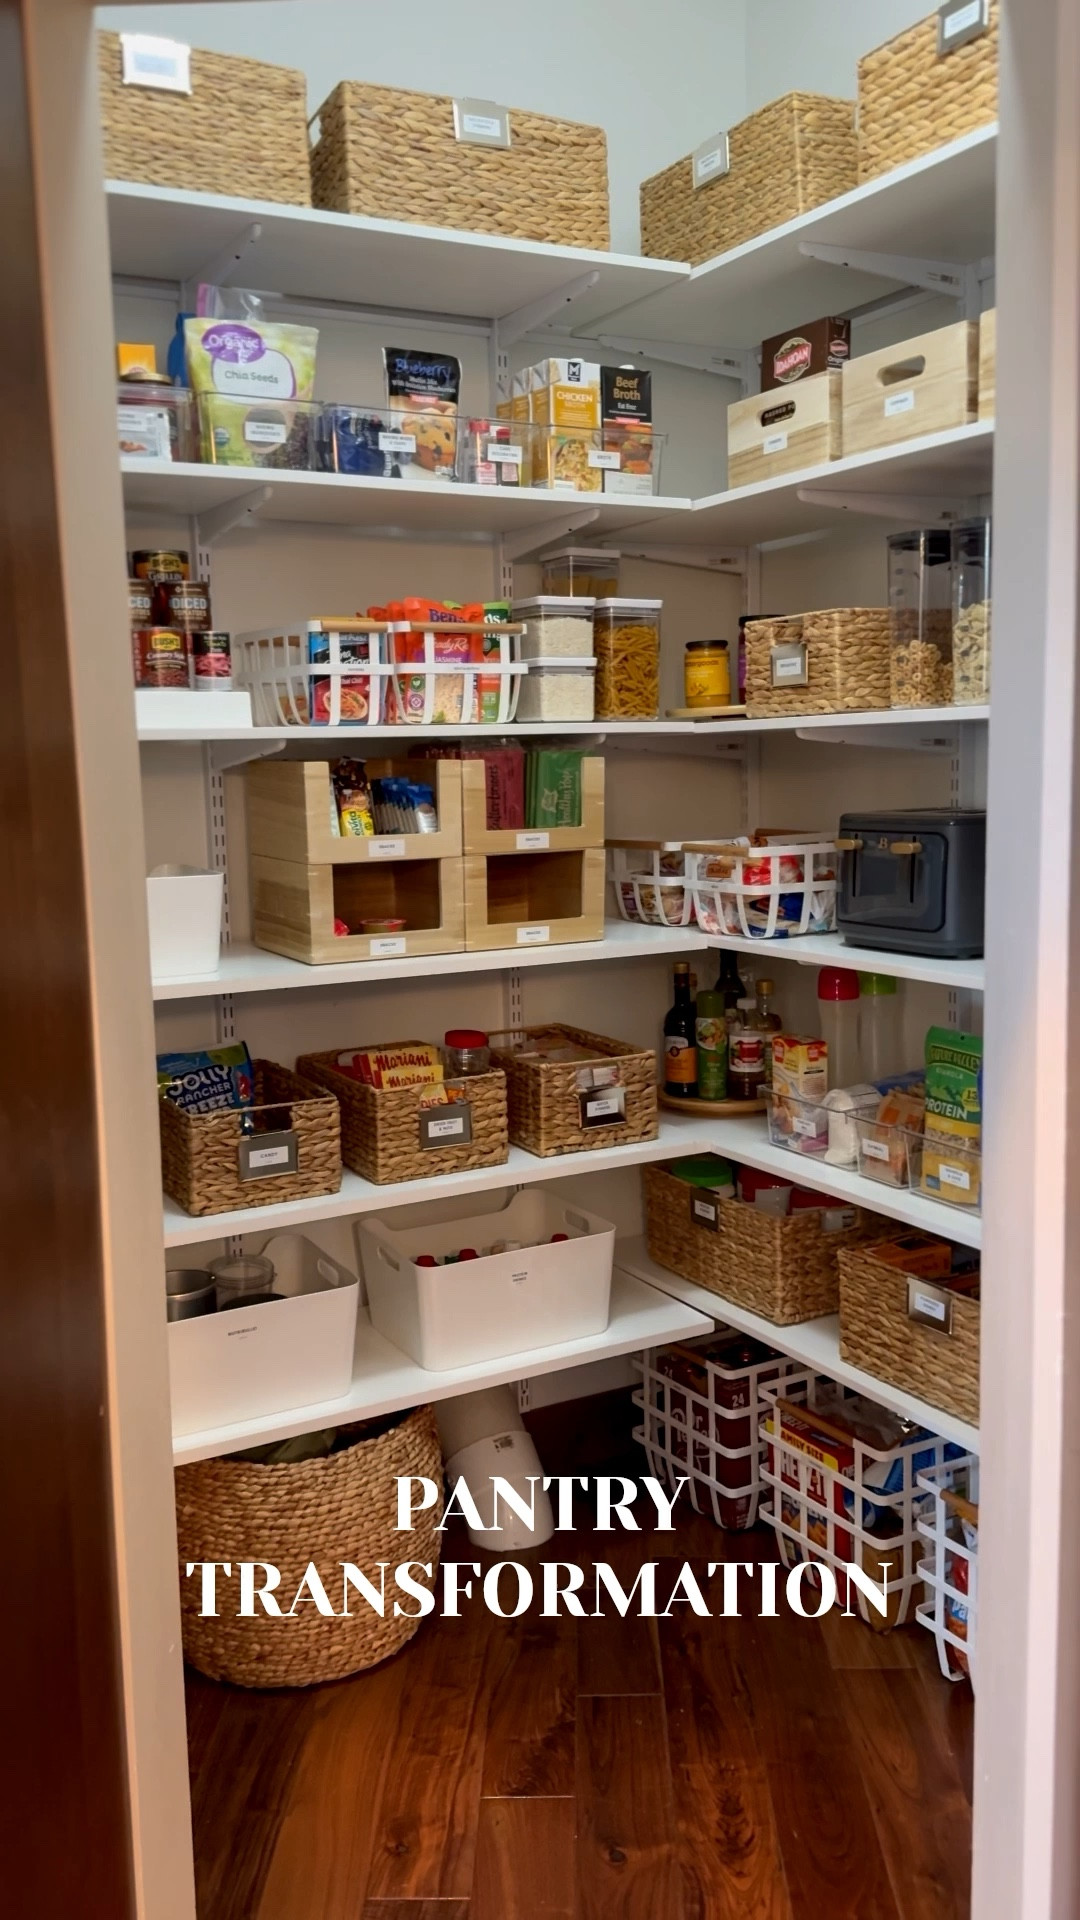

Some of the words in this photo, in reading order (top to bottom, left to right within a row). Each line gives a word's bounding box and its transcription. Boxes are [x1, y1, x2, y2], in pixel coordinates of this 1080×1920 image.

[208, 334, 260, 350] Organic
[225, 370, 249, 380] Chia
[250, 371, 278, 384] Seeds
[395, 358, 452, 382] Blueberry
[615, 376, 639, 388] Beef
[556, 391, 593, 403] CHICKEN
[613, 388, 641, 401] Broth
[172, 597, 208, 609] DICED
[373, 1051, 433, 1072] Mariani
[169, 1065, 230, 1096] JOLLY
[386, 1072, 435, 1088] Mariani
[177, 1082, 232, 1106] RANCHER
[184, 1092, 236, 1115] REEZE
[731, 1392, 746, 1408] 24
[781, 1429, 805, 1451] AMILY
